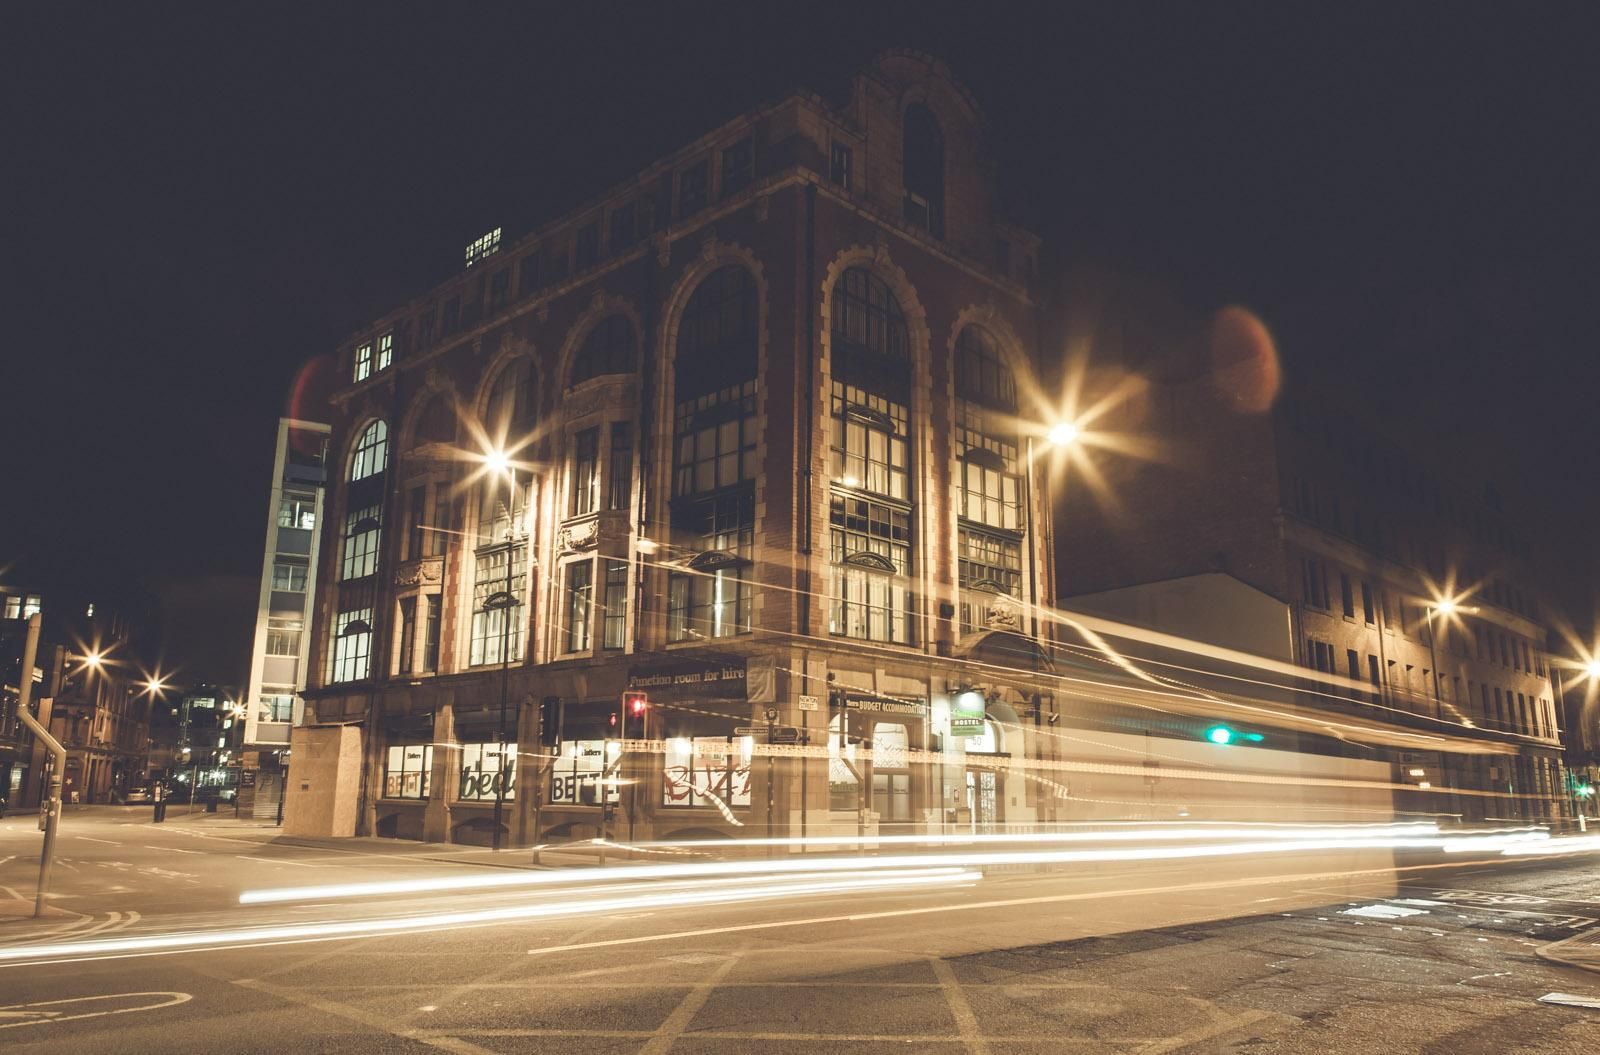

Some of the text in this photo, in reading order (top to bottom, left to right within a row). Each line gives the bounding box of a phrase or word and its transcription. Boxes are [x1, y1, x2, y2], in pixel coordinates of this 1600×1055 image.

[630, 667, 745, 687] Function room for hire
[860, 700, 882, 711] BUDGET
[882, 702, 926, 714] ACCOMMODATION
